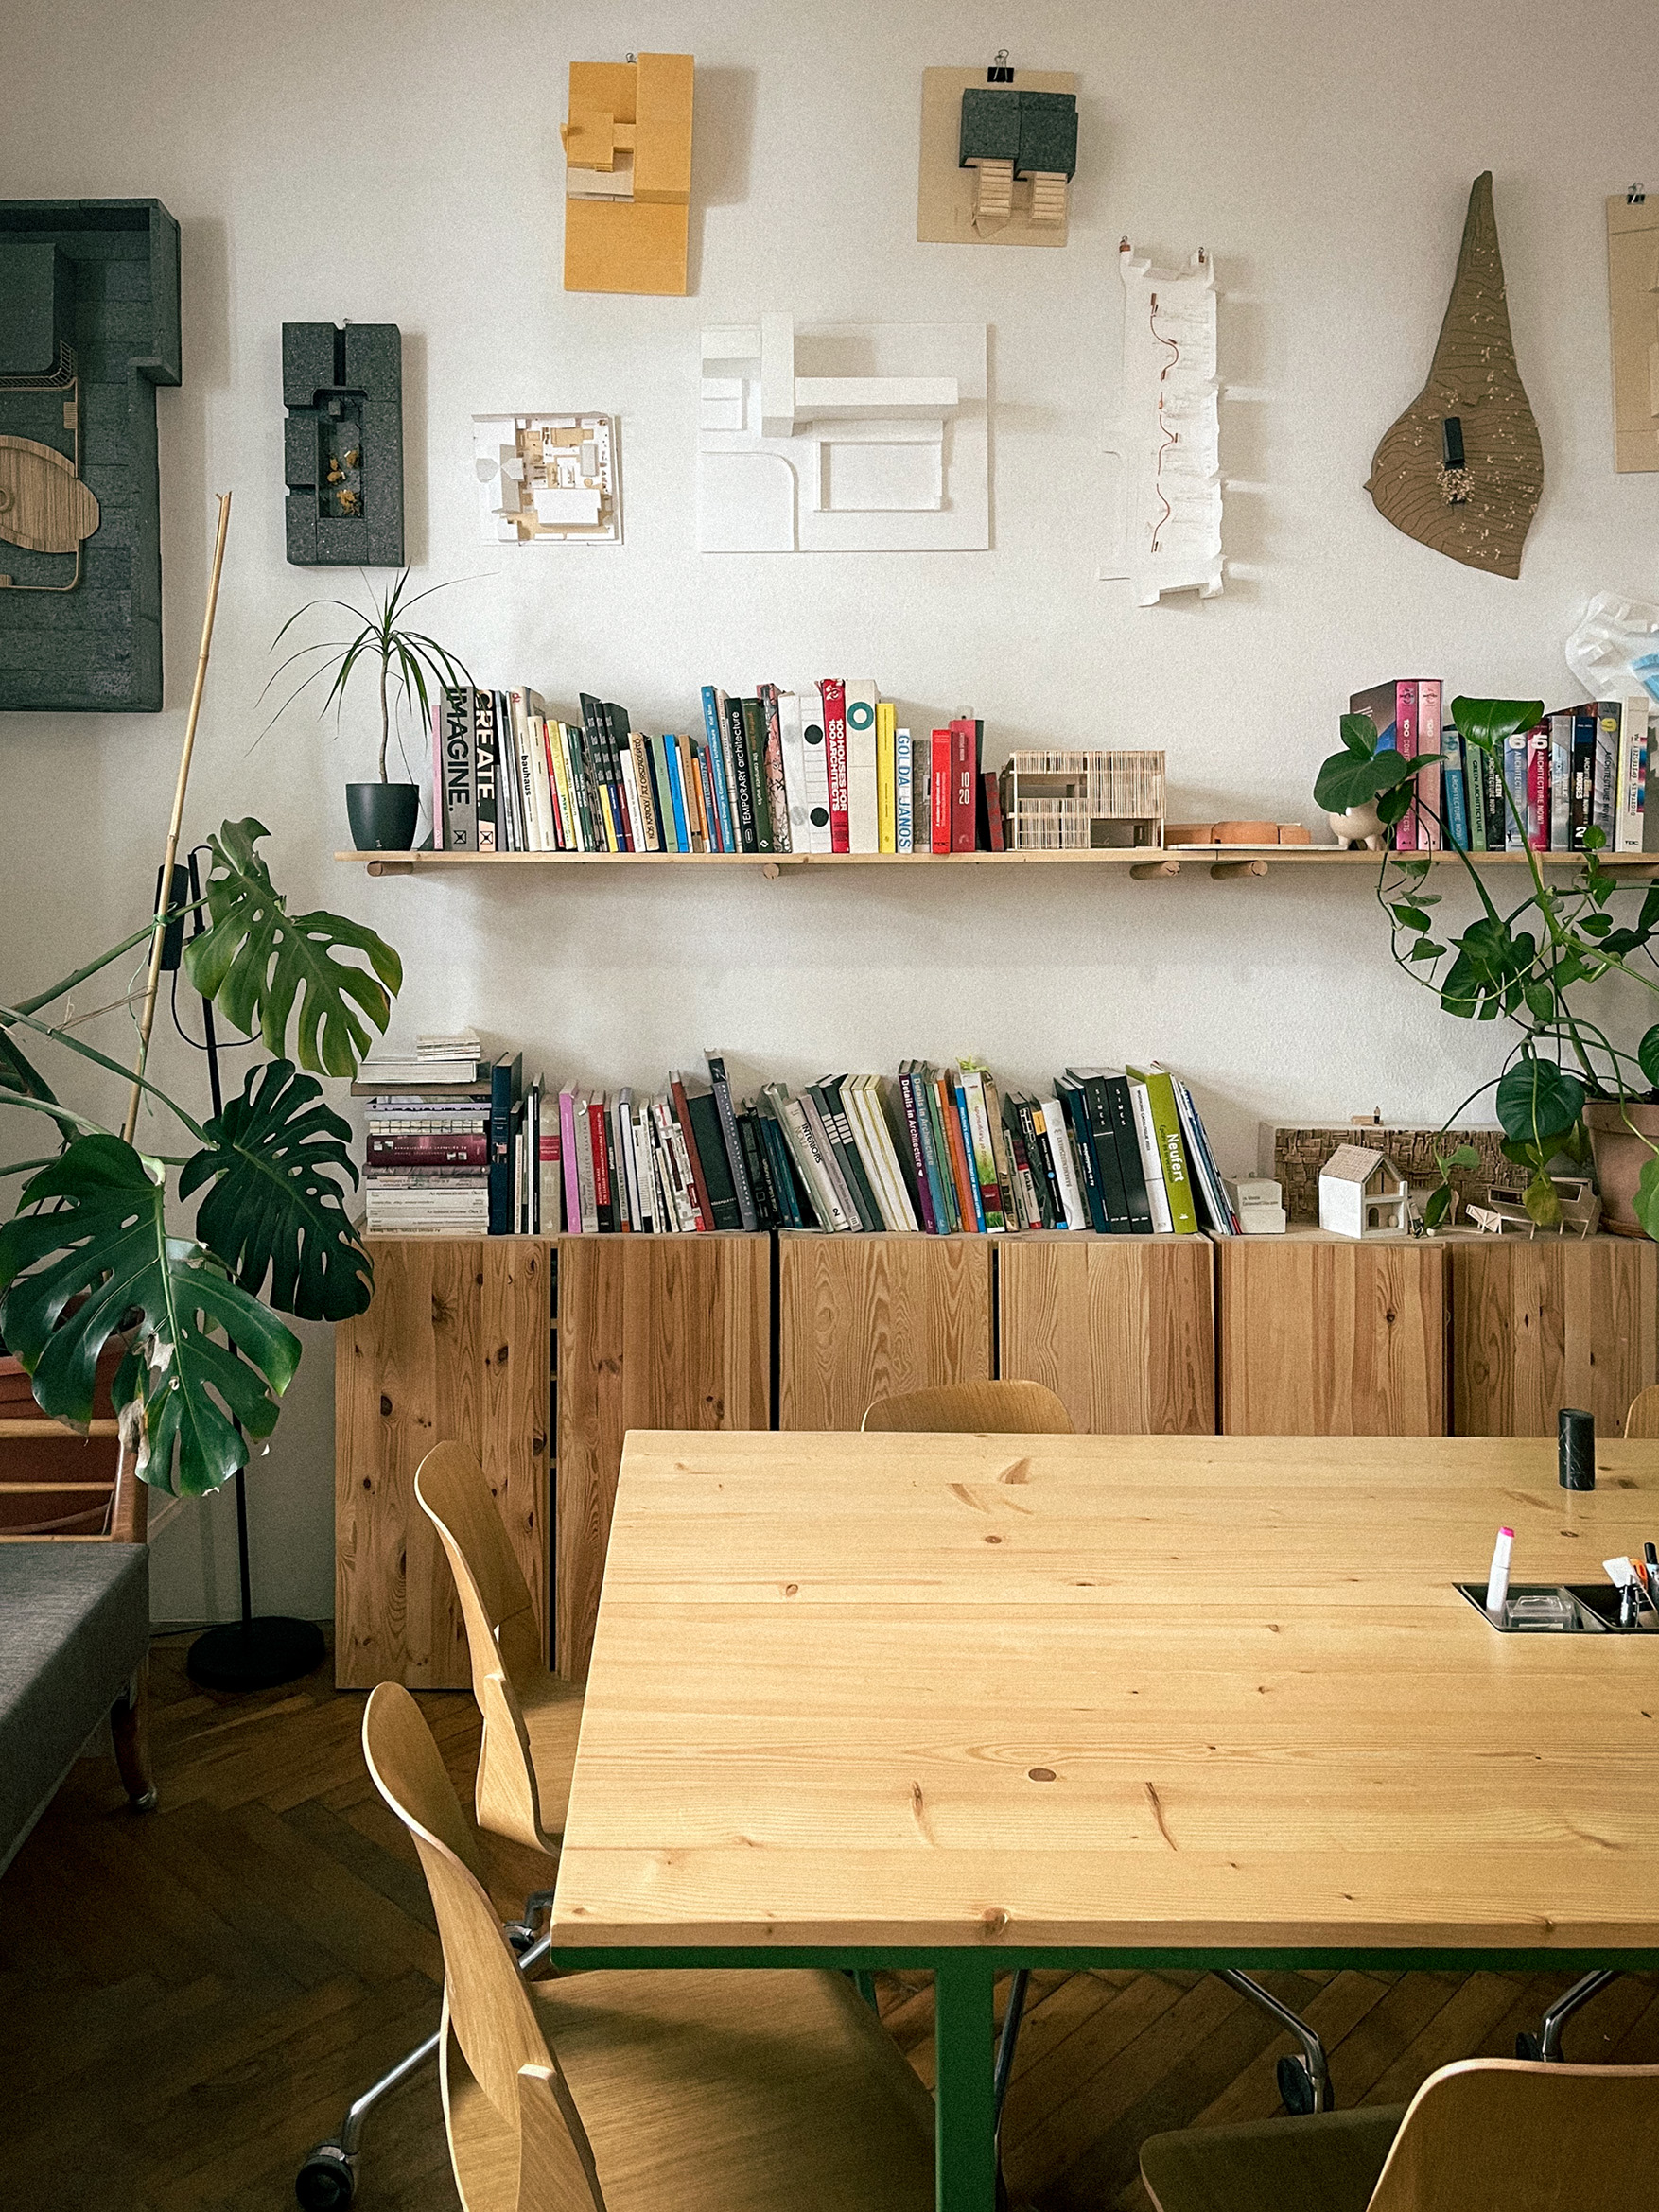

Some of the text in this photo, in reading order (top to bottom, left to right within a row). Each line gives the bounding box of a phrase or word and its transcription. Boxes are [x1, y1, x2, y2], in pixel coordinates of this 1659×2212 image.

[446, 688, 470, 811] IMAGINE.
[475, 690, 495, 807] CREATE.
[710, 730, 719, 759] Architecture
[837, 740, 846, 787] HOUSES
[898, 735, 910, 786] GOLDA
[1532, 734, 1548, 749] 5
[521, 755, 531, 796] bauhaus
[715, 760, 724, 794] Contemporary
[732, 711, 751, 824] TEMPORARY architecture
[830, 740, 840, 811] ARCHITECTS
[961, 772, 969, 787] 10
[1514, 751, 1522, 806] ARCHITECTURE
[1576, 772, 1584, 799] HOUSES
[1603, 752, 1612, 802] ARCHITECTURE
[959, 789, 970, 804] 20
[1451, 775, 1462, 820] ARCHITECTURE
[1474, 783, 1482, 832] ARCHITECTURE
[1575, 826, 1587, 838] 2
[802, 1123, 822, 1163] INTERIORS
[901, 1079, 923, 1167] Details in Architecture
[913, 1078, 924, 1106] Details
[921, 1117, 934, 1165] Architecture
[1140, 1113, 1148, 1139] CATALOGUE
[1167, 1134, 1184, 1182] Neufert
[833, 1208, 840, 1216] 2
